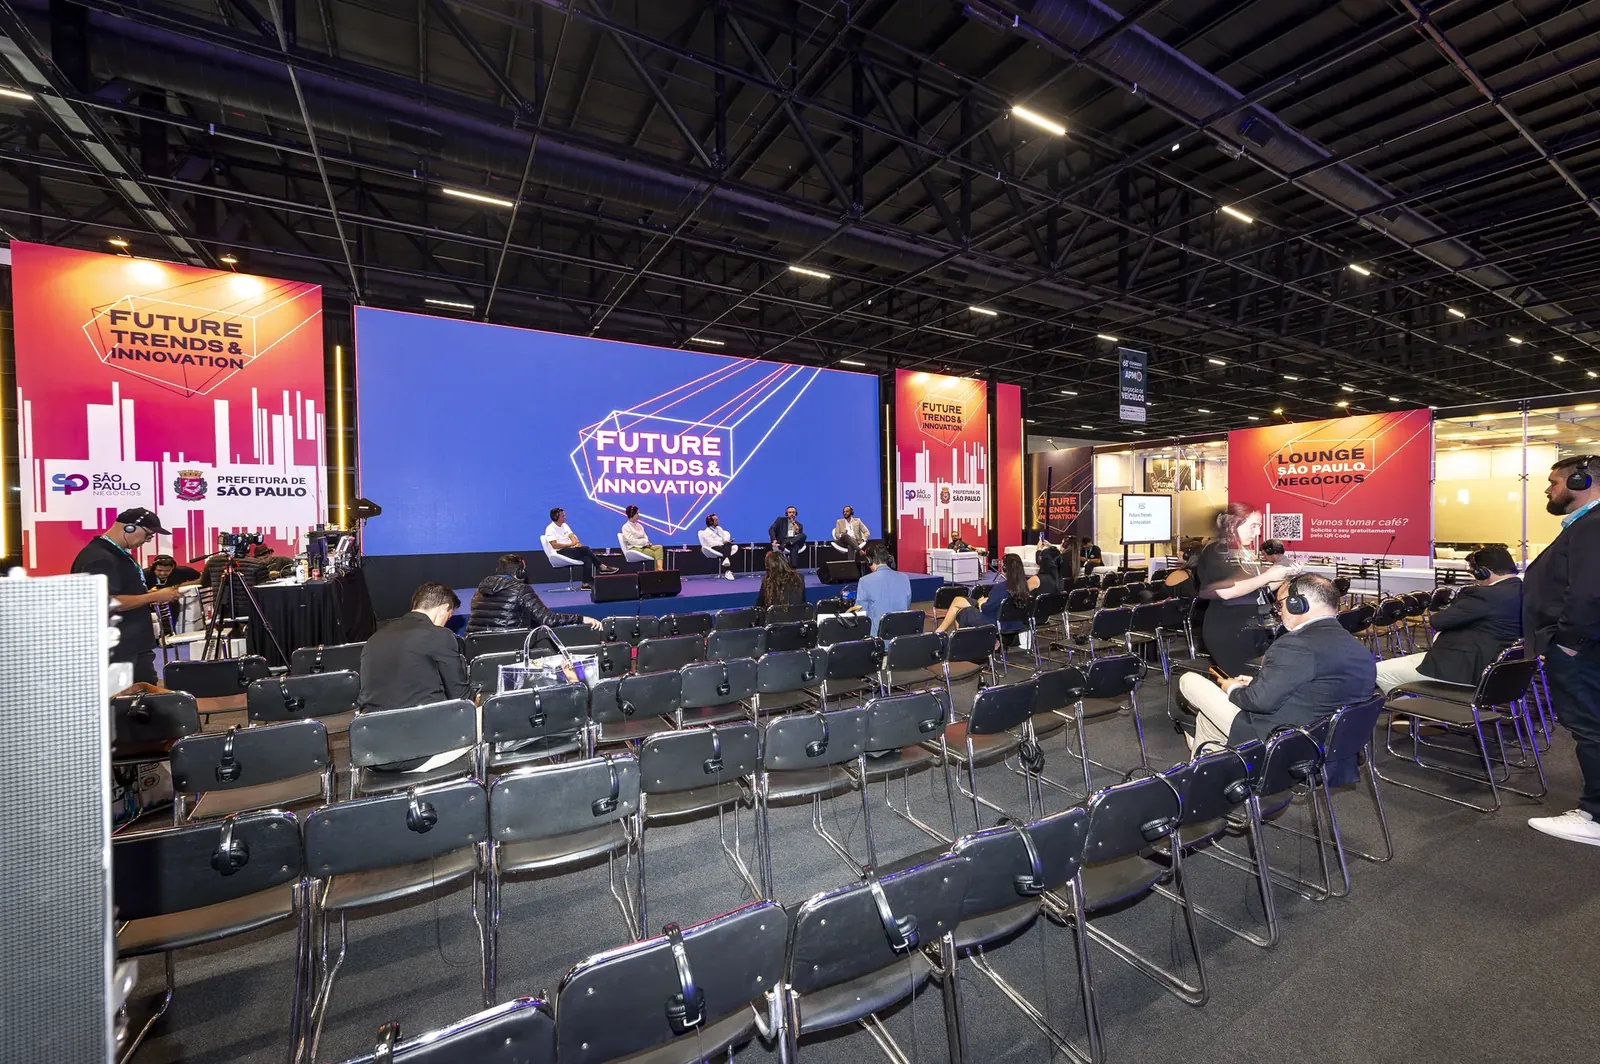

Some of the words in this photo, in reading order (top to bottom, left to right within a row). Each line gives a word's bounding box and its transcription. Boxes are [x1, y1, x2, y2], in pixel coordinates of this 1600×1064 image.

[110, 309, 243, 338] FUTURE
[111, 347, 244, 370] INNOVATION
[922, 402, 962, 414] FUTURE
[922, 422, 962, 431] INNOVATION
[596, 430, 721, 456] FUTURE
[1278, 448, 1364, 464] LOUNGE
[1277, 464, 1308, 475] SÃO
[1311, 462, 1366, 473] PAULO
[92, 472, 122, 482] SÃO
[217, 476, 288, 484] PREFEITURA
[1278, 474, 1364, 486] NEGÓCIOS
[92, 482, 141, 491] PAULO
[216, 484, 252, 496] SÃO
[255, 486, 307, 497] PAULO
[597, 478, 723, 495] INNOVATION
[1038, 497, 1076, 505] FTURE
[1378, 518, 1408, 526] café?
